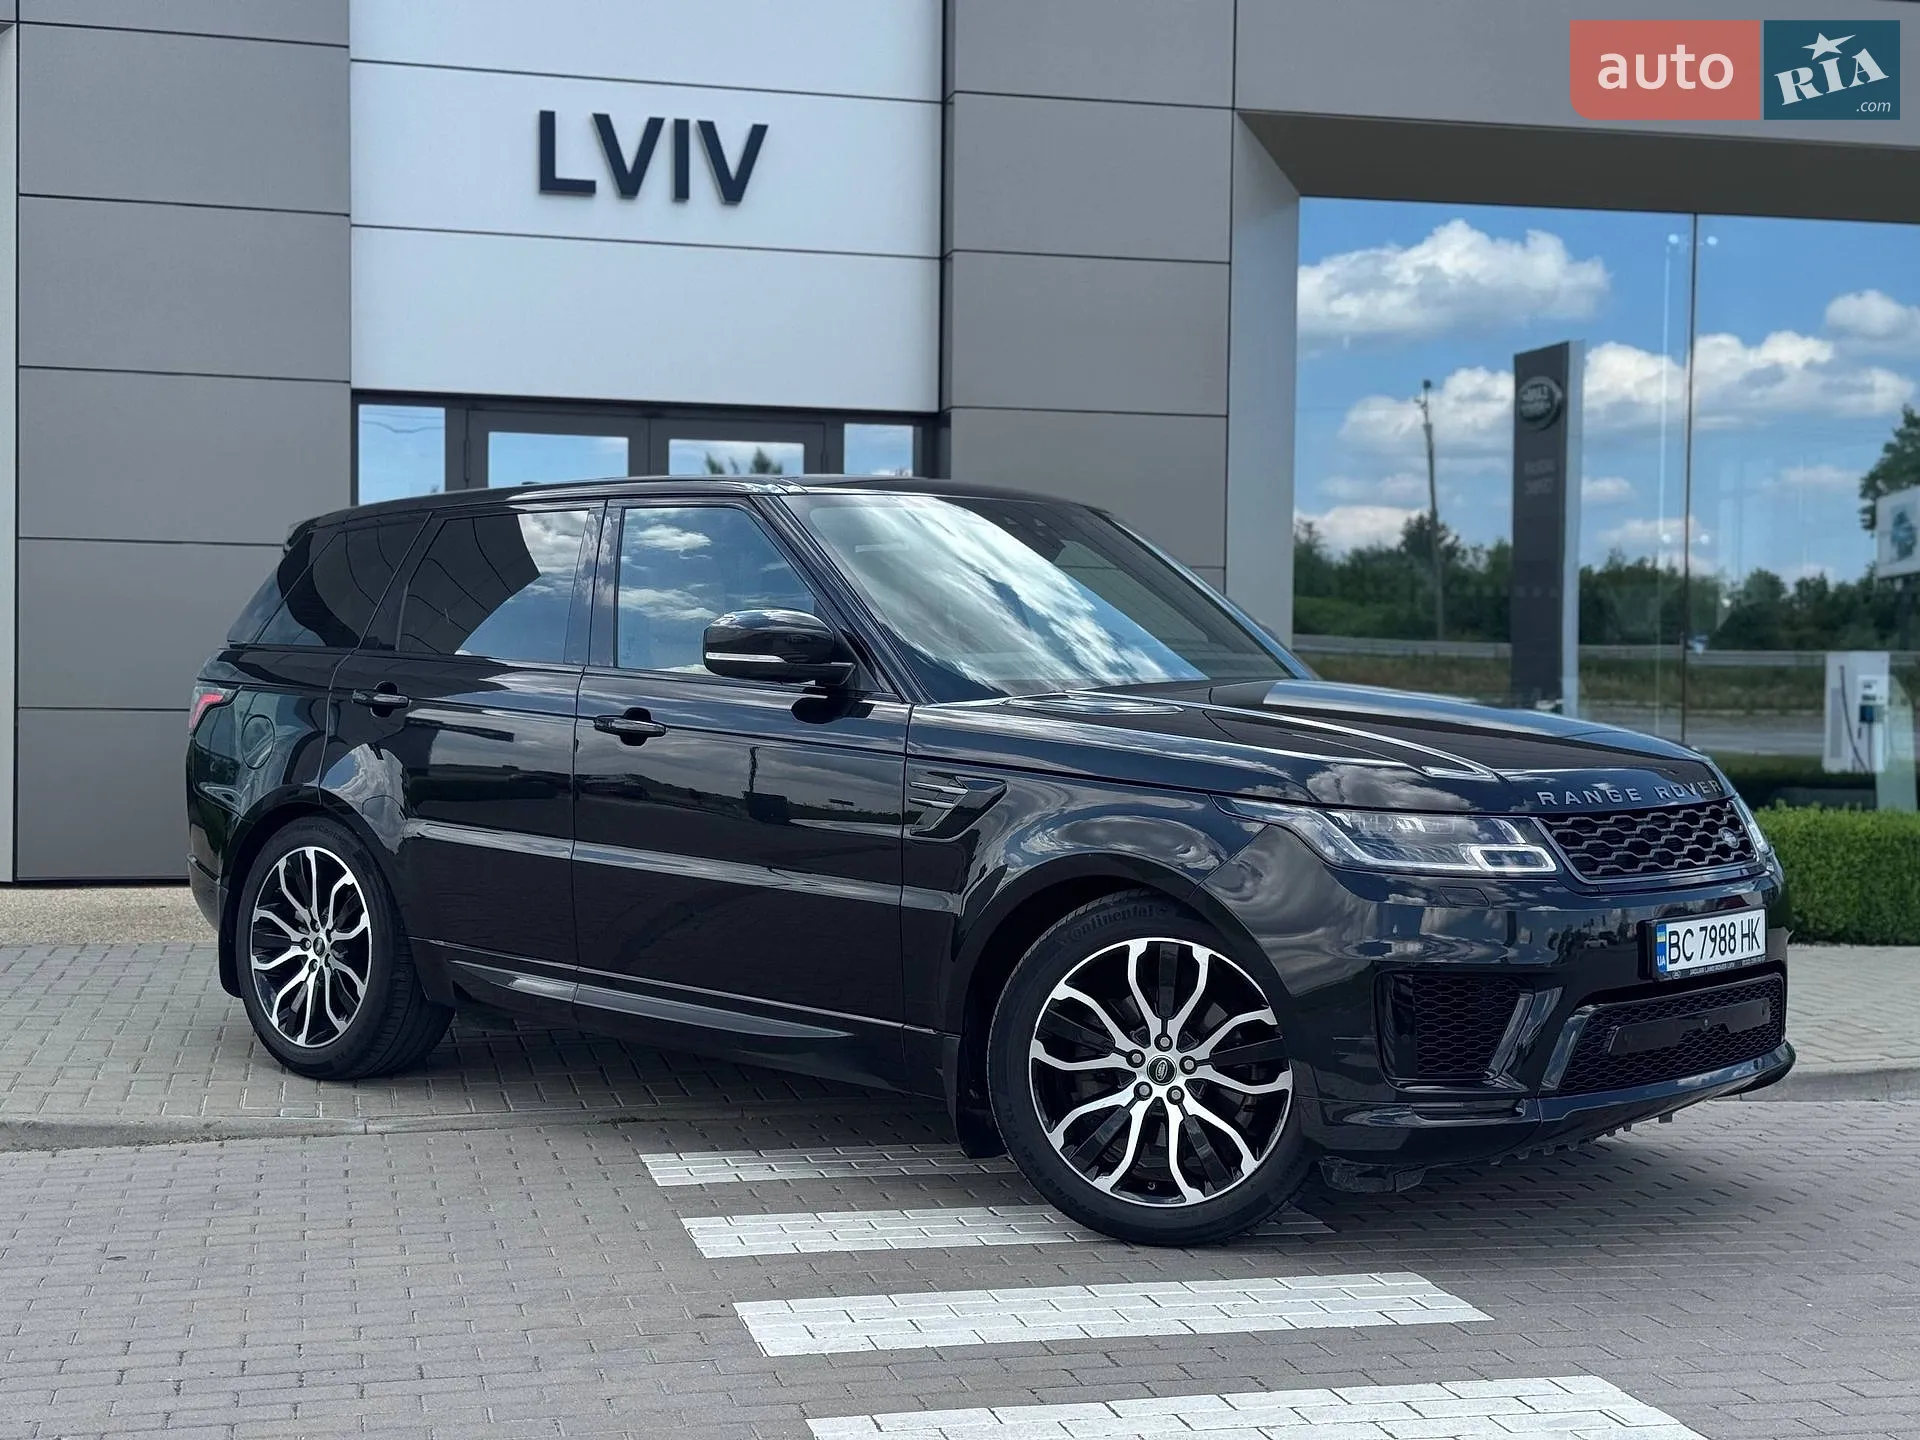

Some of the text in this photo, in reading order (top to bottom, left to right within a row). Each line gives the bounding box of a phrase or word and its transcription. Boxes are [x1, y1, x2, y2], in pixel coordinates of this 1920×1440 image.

[537, 109, 769, 206] LVIV
[1537, 779, 1722, 806] RANGE ROVER
[1668, 917, 1760, 965] BC 7988 HK
[1656, 955, 1666, 967] UA
